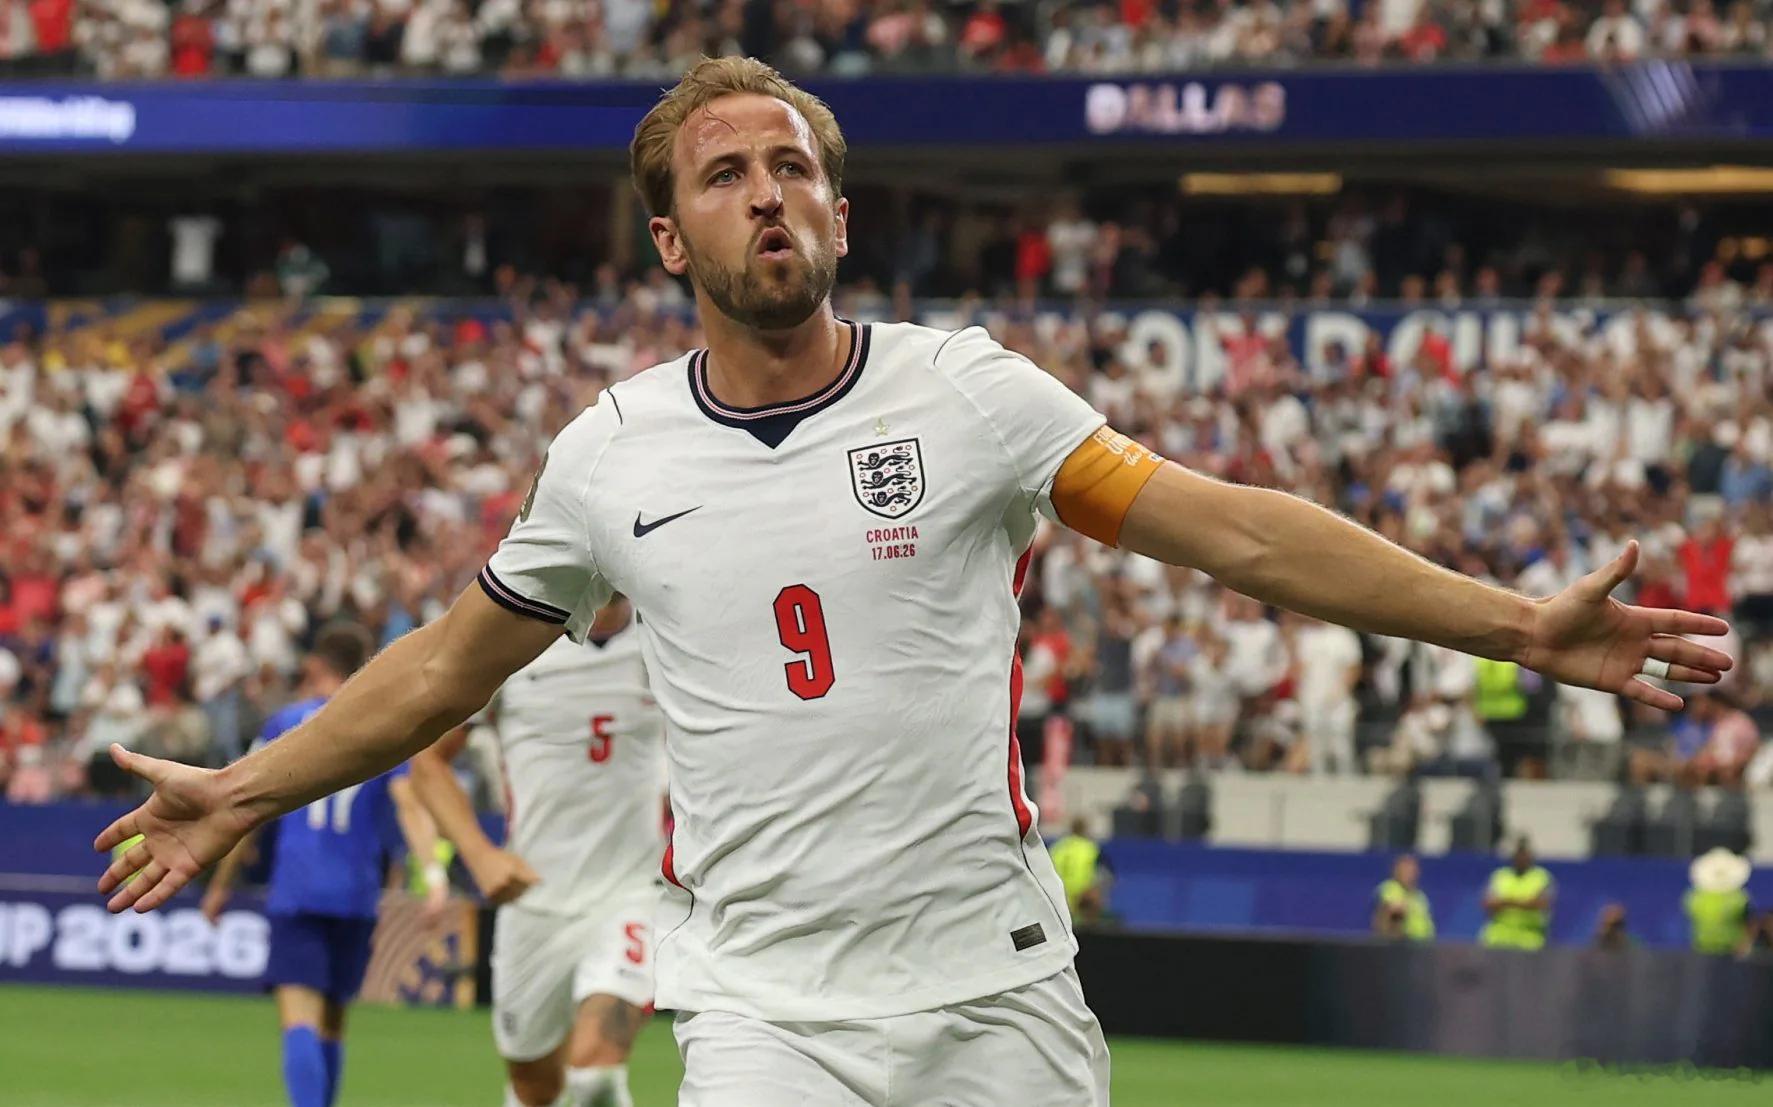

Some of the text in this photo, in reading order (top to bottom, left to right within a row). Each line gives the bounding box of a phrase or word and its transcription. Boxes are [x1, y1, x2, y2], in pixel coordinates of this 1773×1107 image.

[866, 526, 919, 543] CROATIA
[872, 544, 916, 560] 17.06.26
[773, 583, 836, 701] 9
[588, 714, 615, 764] 5
[53, 904, 272, 978] 2026
[623, 921, 647, 965] 5
